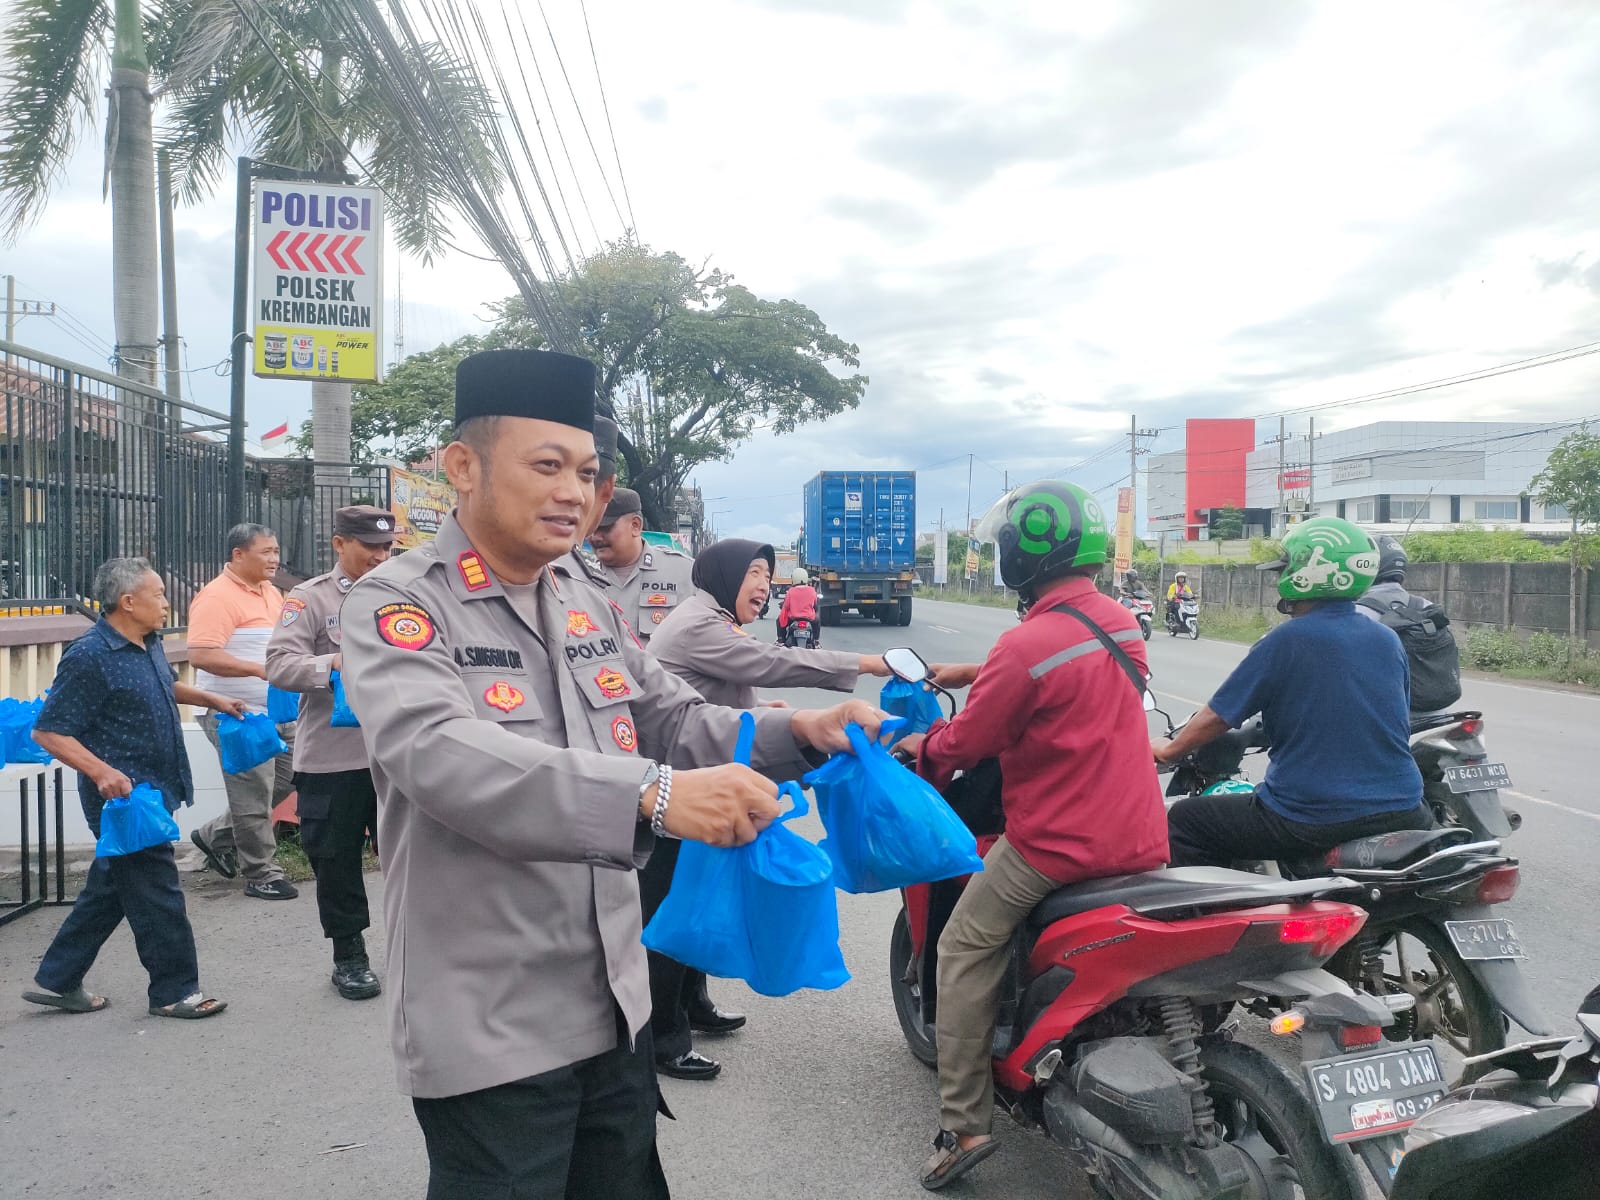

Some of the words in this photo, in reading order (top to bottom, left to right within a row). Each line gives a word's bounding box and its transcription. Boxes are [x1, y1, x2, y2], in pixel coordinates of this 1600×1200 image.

[262, 191, 371, 231] POLISI
[276, 275, 355, 301] POLSEK
[261, 299, 371, 328] KREMBANGAN
[265, 341, 285, 349] ABC
[293, 338, 313, 347] ABC
[336, 341, 369, 350] POWER
[407, 508, 437, 521] ANGGOTA
[641, 583, 677, 592] POLRI
[565, 638, 619, 663] POLRI
[1448, 770, 1456, 781] W
[1459, 767, 1482, 779] 6431
[1451, 927, 1466, 943] L
[1319, 1073, 1336, 1102] S
[1345, 1062, 1391, 1097] 4804
[1398, 1053, 1436, 1087] JAW
